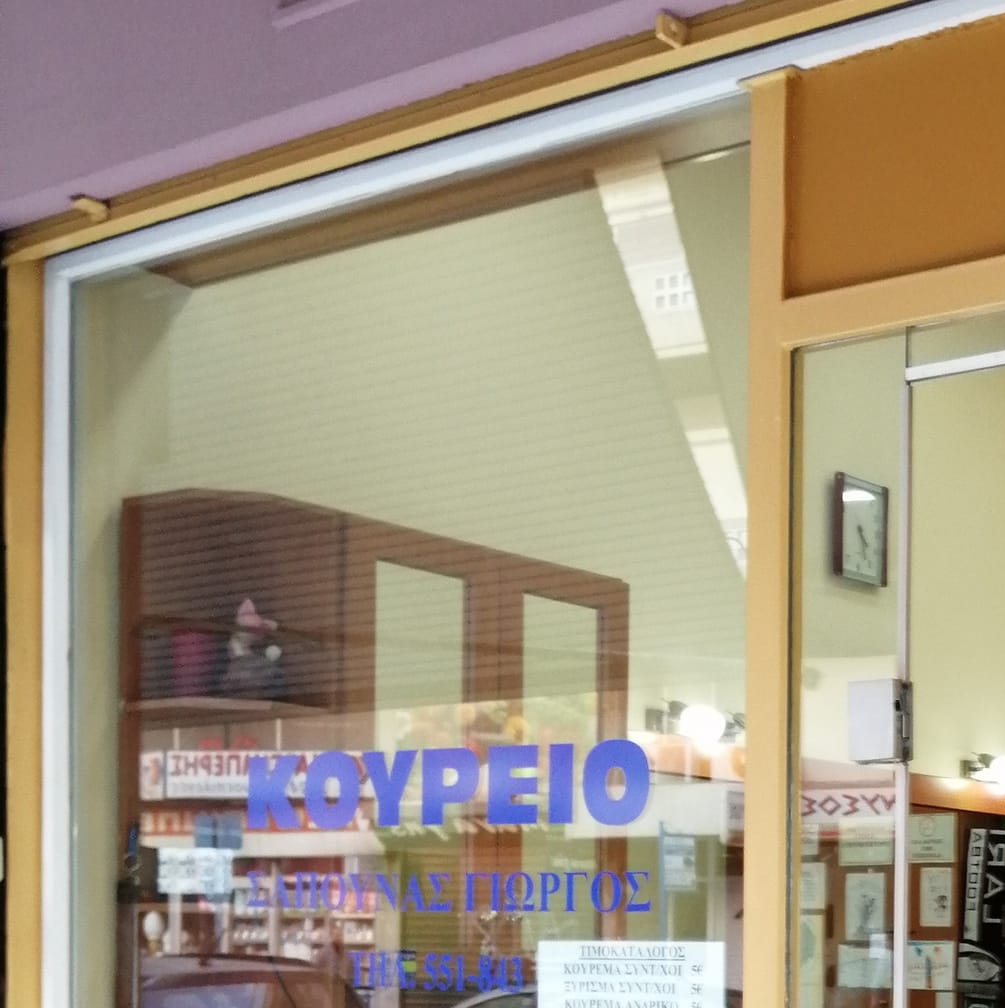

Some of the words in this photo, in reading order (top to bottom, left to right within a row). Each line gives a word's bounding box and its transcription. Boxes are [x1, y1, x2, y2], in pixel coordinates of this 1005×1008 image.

[246, 738, 651, 830] ΚΟΥΡΕΙΟ
[465, 871, 652, 912] ΓΙΩΡΓΟΣ
[423, 953, 524, 994] 551-843
[563, 963, 621, 976] ΚΟΥΡΕΜΑ
[563, 981, 615, 993] ΞΥΡΙΣΜΑ
